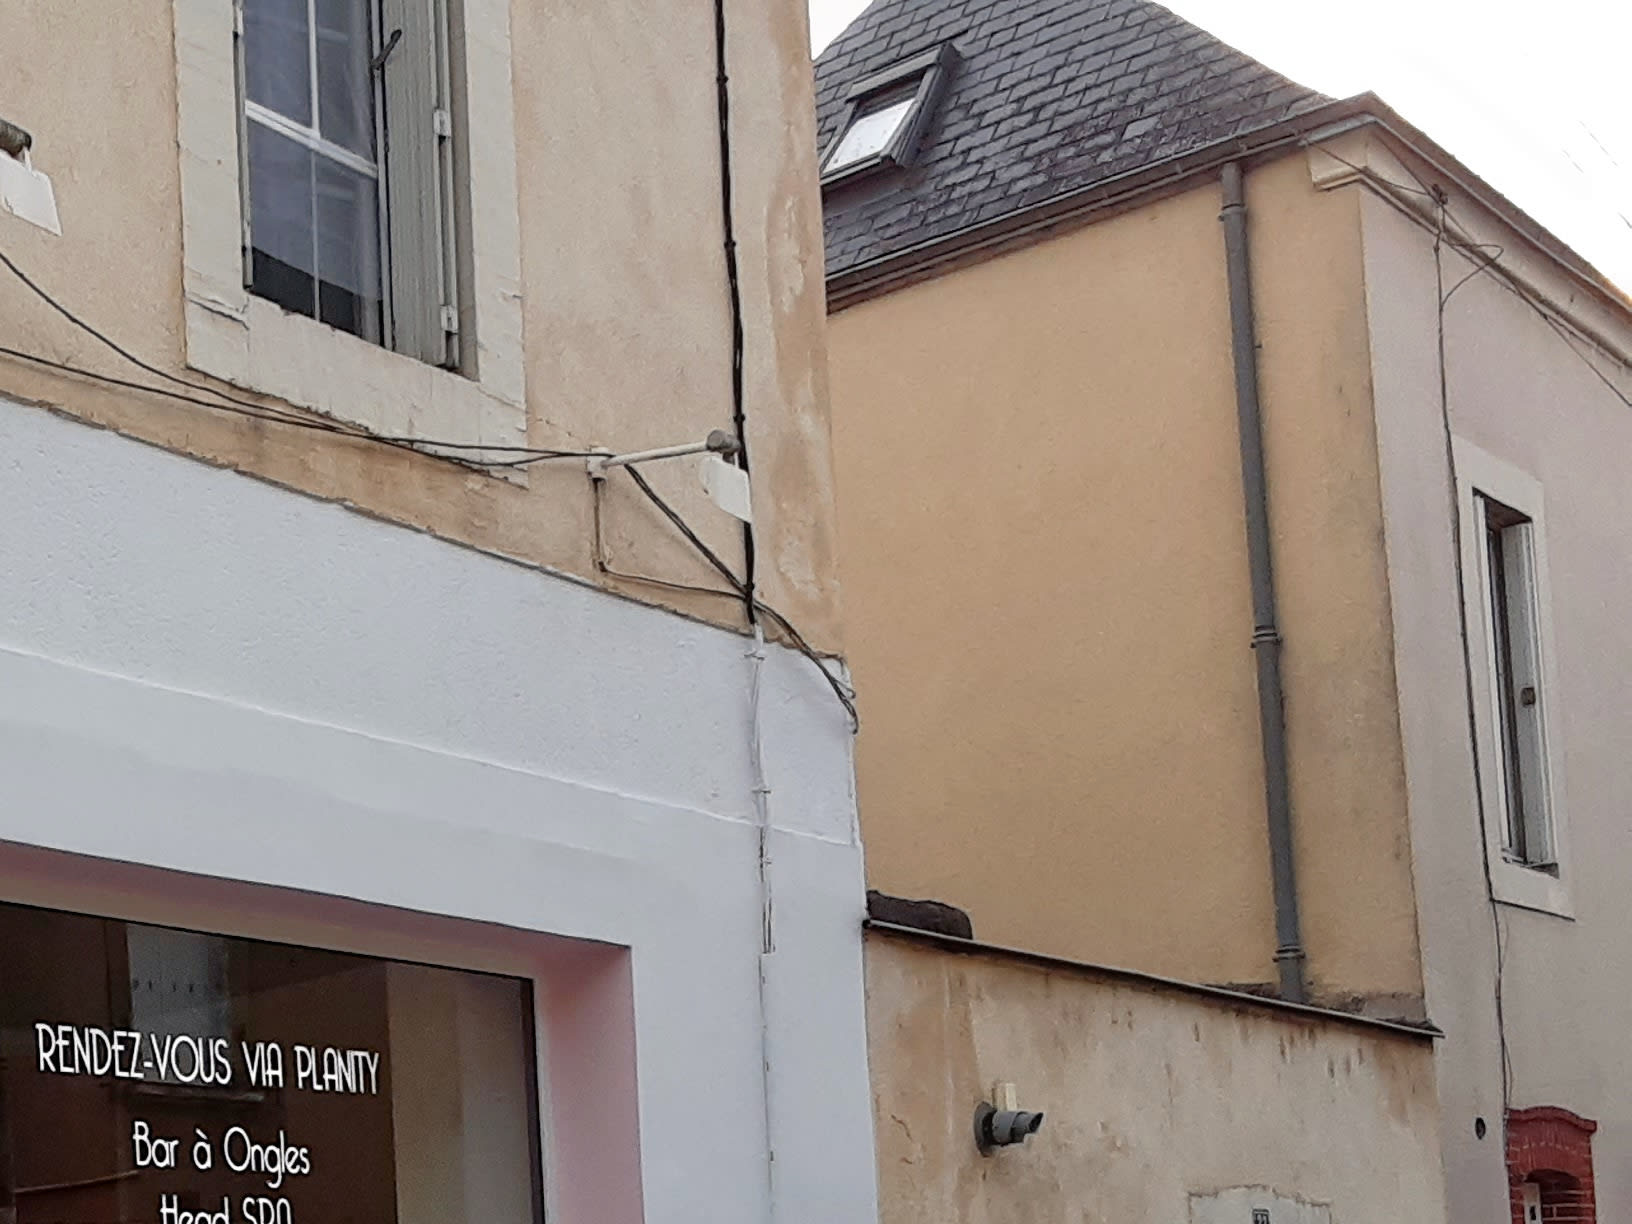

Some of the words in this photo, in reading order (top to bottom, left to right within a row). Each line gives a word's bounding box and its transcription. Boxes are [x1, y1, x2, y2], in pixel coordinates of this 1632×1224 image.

[35, 1023, 230, 1084] RENDEZ-VOUS
[242, 1042, 282, 1086] VIA
[294, 1045, 378, 1092] PLANITY
[132, 1121, 178, 1167] Bar
[193, 1129, 211, 1169] à
[224, 1126, 309, 1188] Ongles
